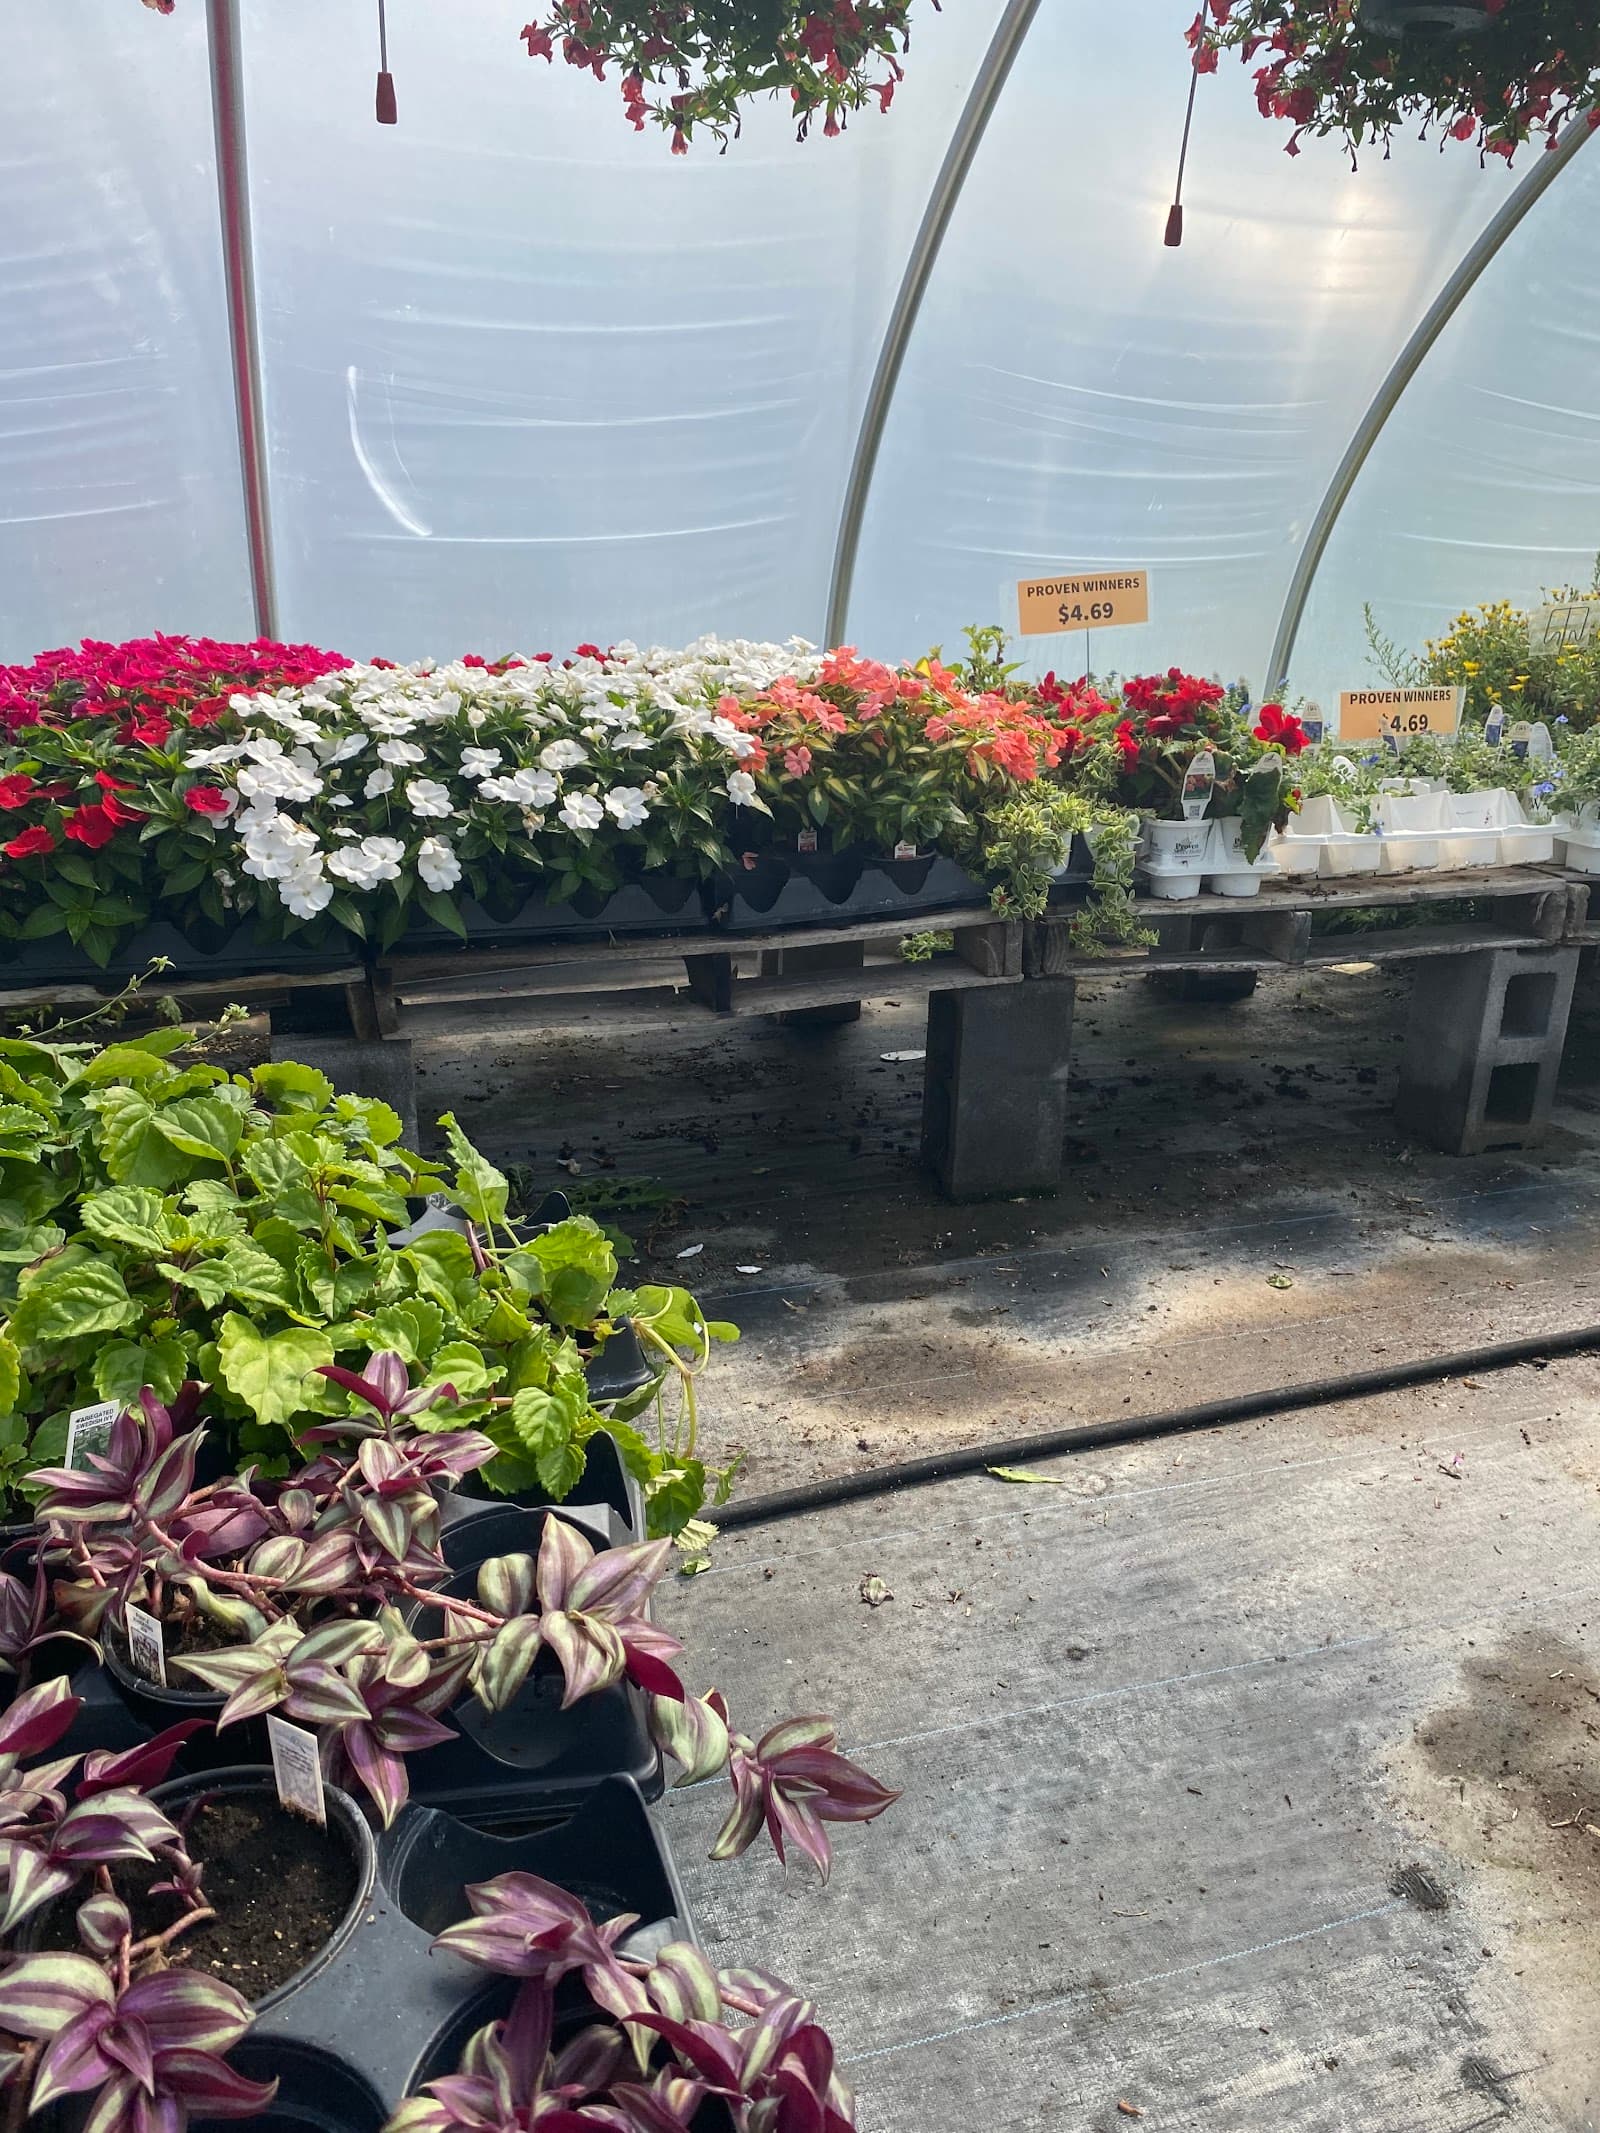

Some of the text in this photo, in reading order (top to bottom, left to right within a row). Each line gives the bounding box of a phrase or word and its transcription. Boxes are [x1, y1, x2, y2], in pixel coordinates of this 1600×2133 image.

[1027, 578, 1140, 597] PROVEN WINNERS
[1058, 602, 1114, 624] $4.69
[1350, 690, 1451, 704] PROVEN WINNERS
[1378, 713, 1428, 733] 4.69
